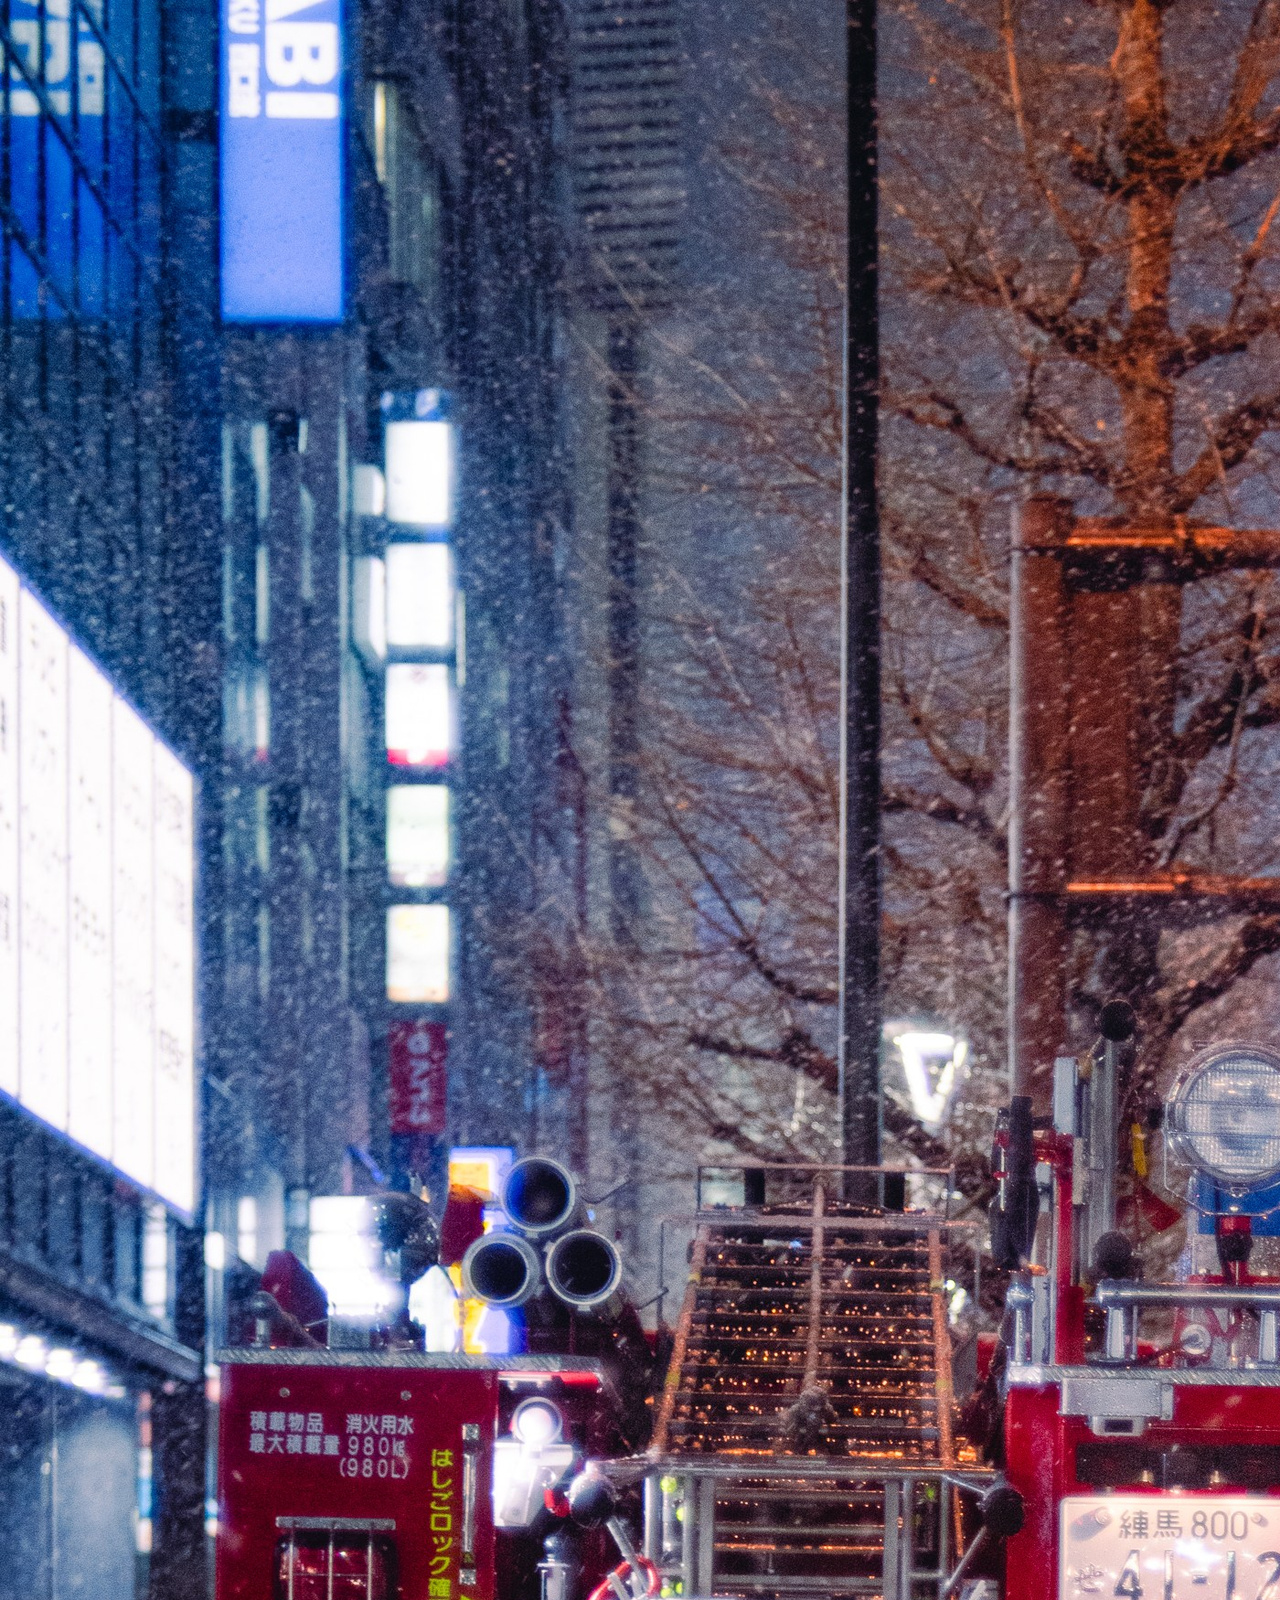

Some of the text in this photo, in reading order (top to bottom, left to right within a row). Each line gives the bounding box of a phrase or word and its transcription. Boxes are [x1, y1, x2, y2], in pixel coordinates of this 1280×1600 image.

[250, 1411, 414, 1436] 積載物品 消火用水
[249, 1433, 340, 1456] 最大積載量
[339, 1457, 409, 1480] (980L)
[1119, 1510, 1249, 1541] 練馬 800
